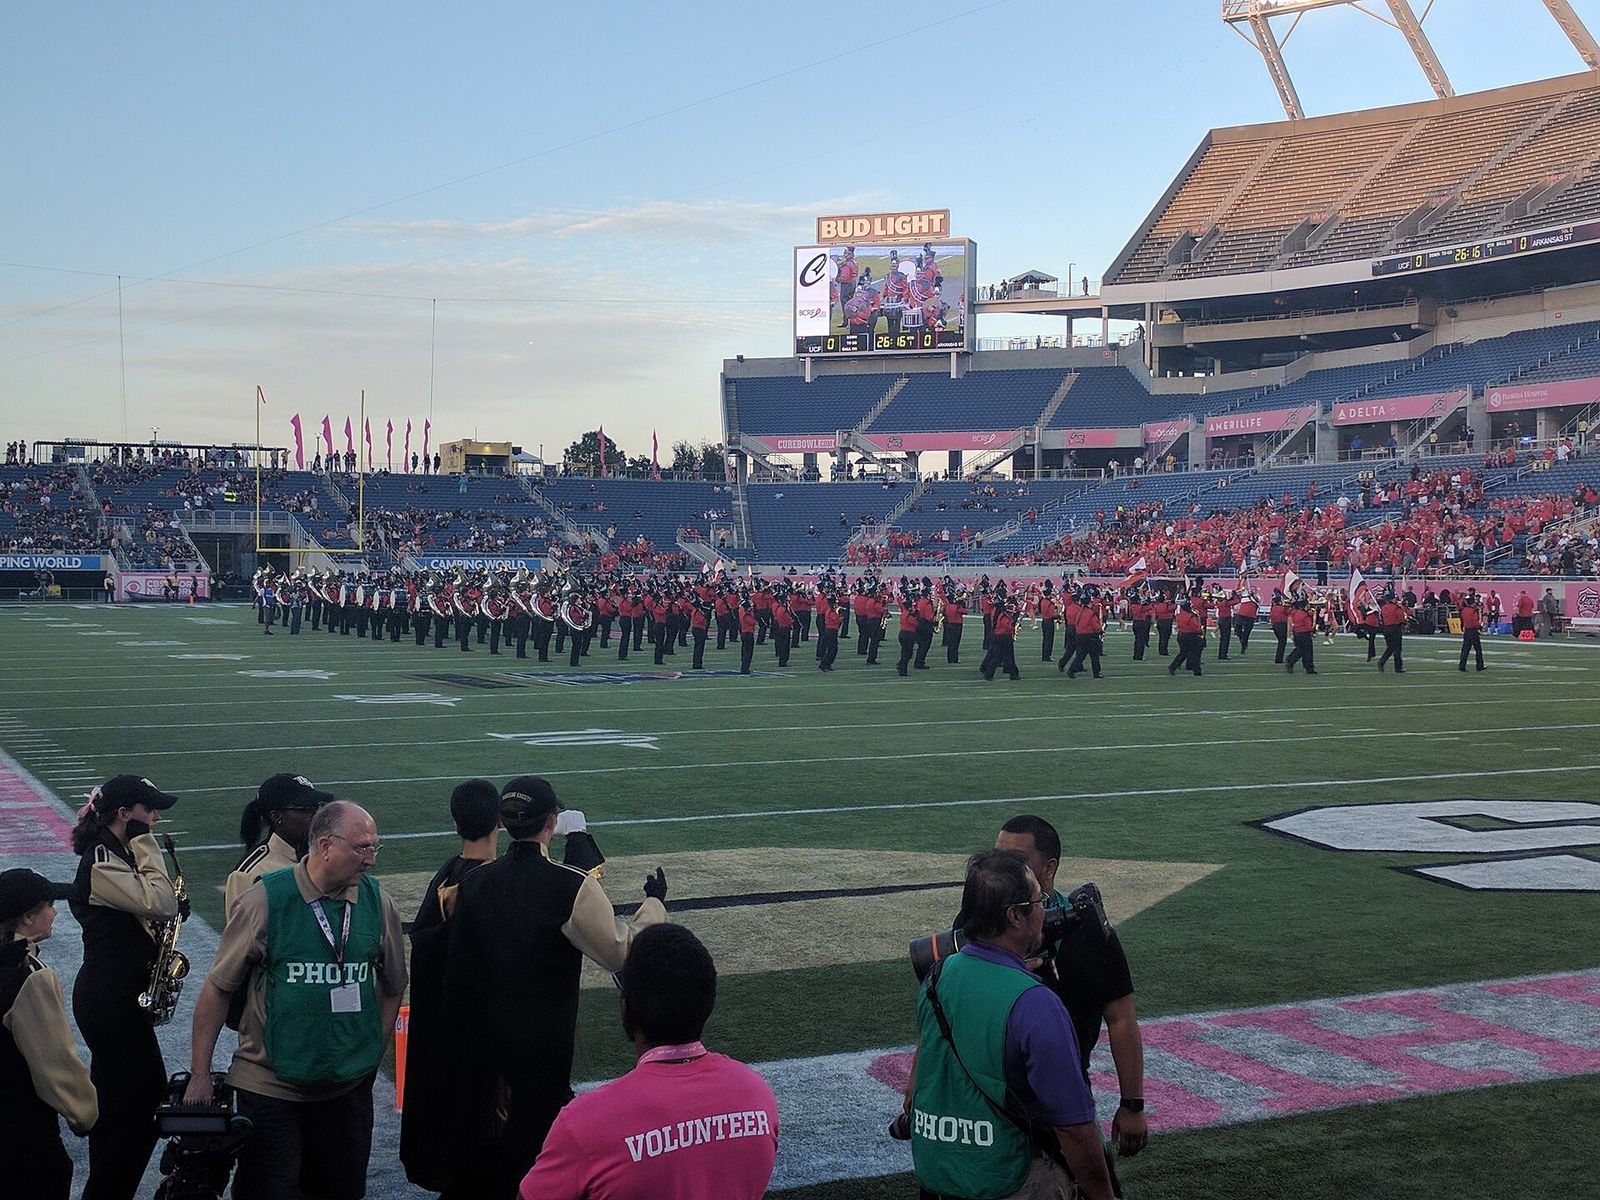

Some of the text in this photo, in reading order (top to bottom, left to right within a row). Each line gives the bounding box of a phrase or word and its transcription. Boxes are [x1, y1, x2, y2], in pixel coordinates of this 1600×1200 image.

[821, 213, 945, 239] BUD LIGHT
[1520, 236, 1527, 250] 0
[1532, 233, 1573, 247] ARKANSAS ST
[1397, 261, 1410, 270] UCF
[1415, 255, 1423, 268] 0
[826, 337, 835, 350] 0
[876, 336, 906, 348] 26:16
[924, 334, 931, 347] 0
[1349, 405, 1386, 418] DELTA
[1209, 417, 1262, 432] AMERILIFE
[32, 557, 82, 569] WORLD
[430, 559, 526, 570] CAMPING WORLD
[286, 961, 369, 984] PHOTO
[914, 1108, 994, 1147] PHOTO
[624, 1109, 771, 1163] VOLUNTEER
